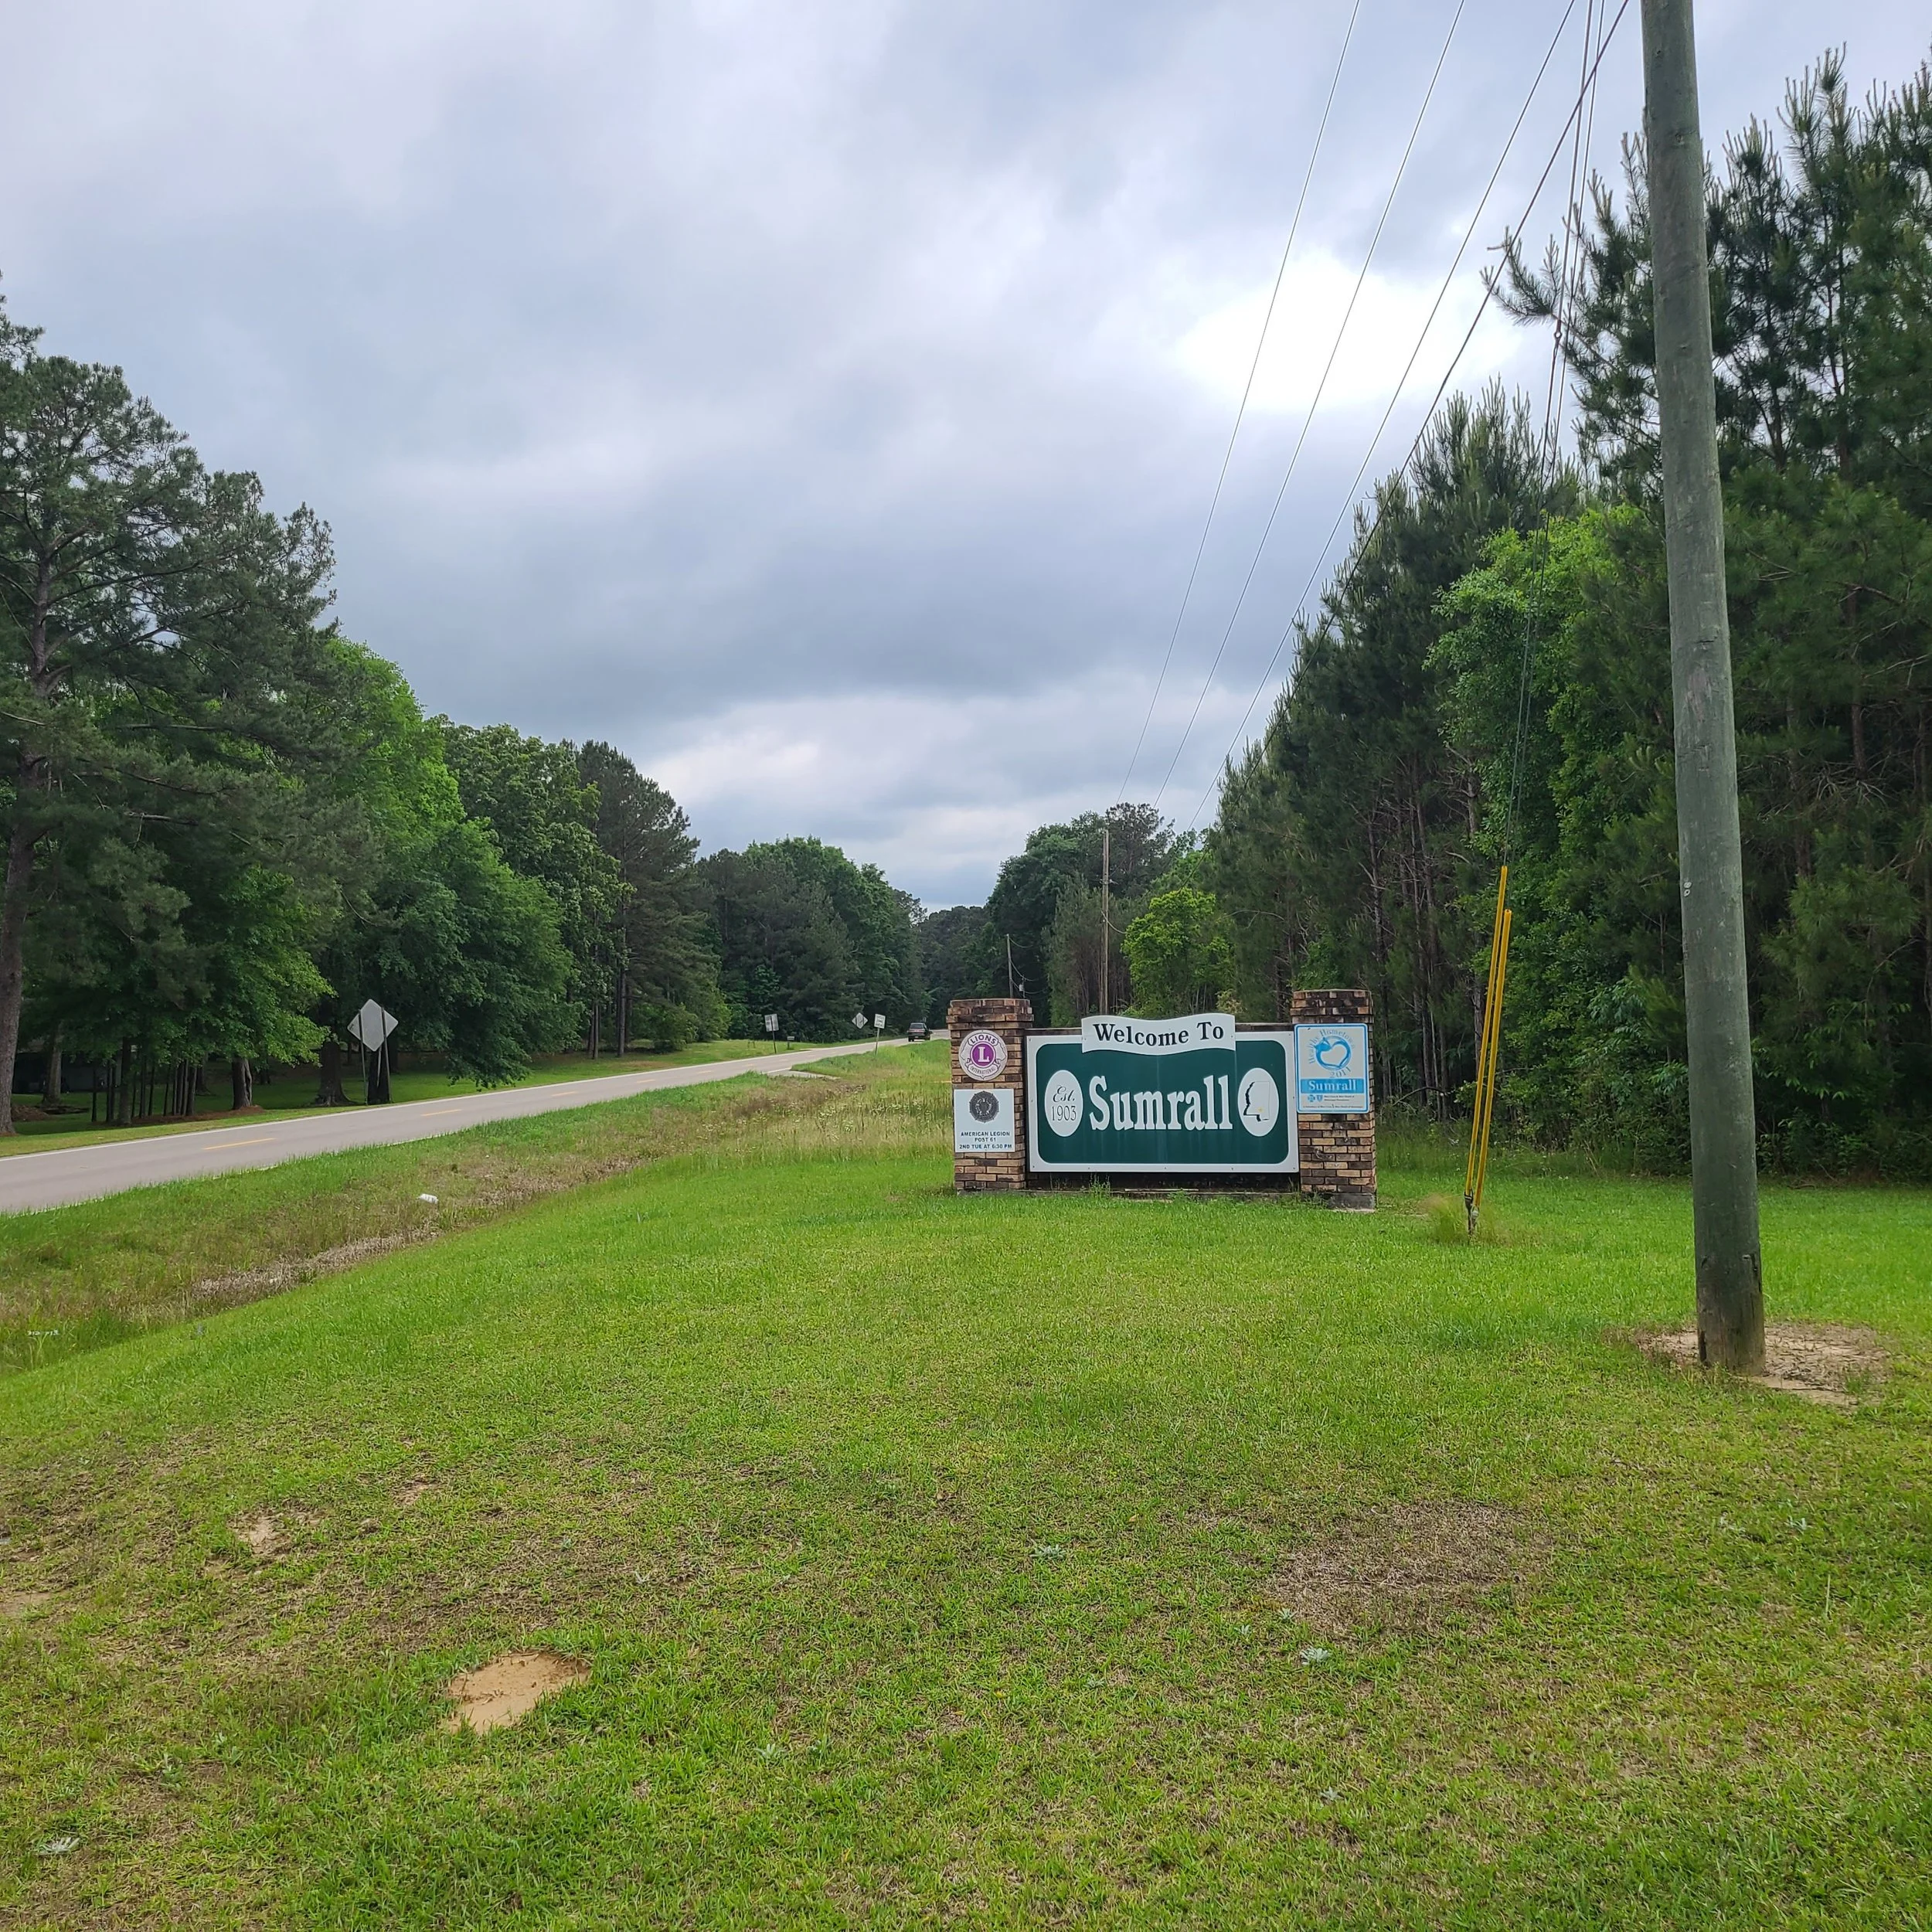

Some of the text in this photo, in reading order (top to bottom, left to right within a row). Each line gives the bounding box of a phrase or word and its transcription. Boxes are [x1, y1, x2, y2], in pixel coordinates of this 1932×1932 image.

[970, 1034, 997, 1044] LIONS
[1093, 1022, 1224, 1046] Welcome To
[978, 1046, 990, 1063] L
[1053, 1084, 1076, 1103] Est.
[1308, 1079, 1356, 1091] Sumrall
[1089, 1074, 1233, 1131] Sumrall
[1051, 1105, 1077, 1121] 1903
